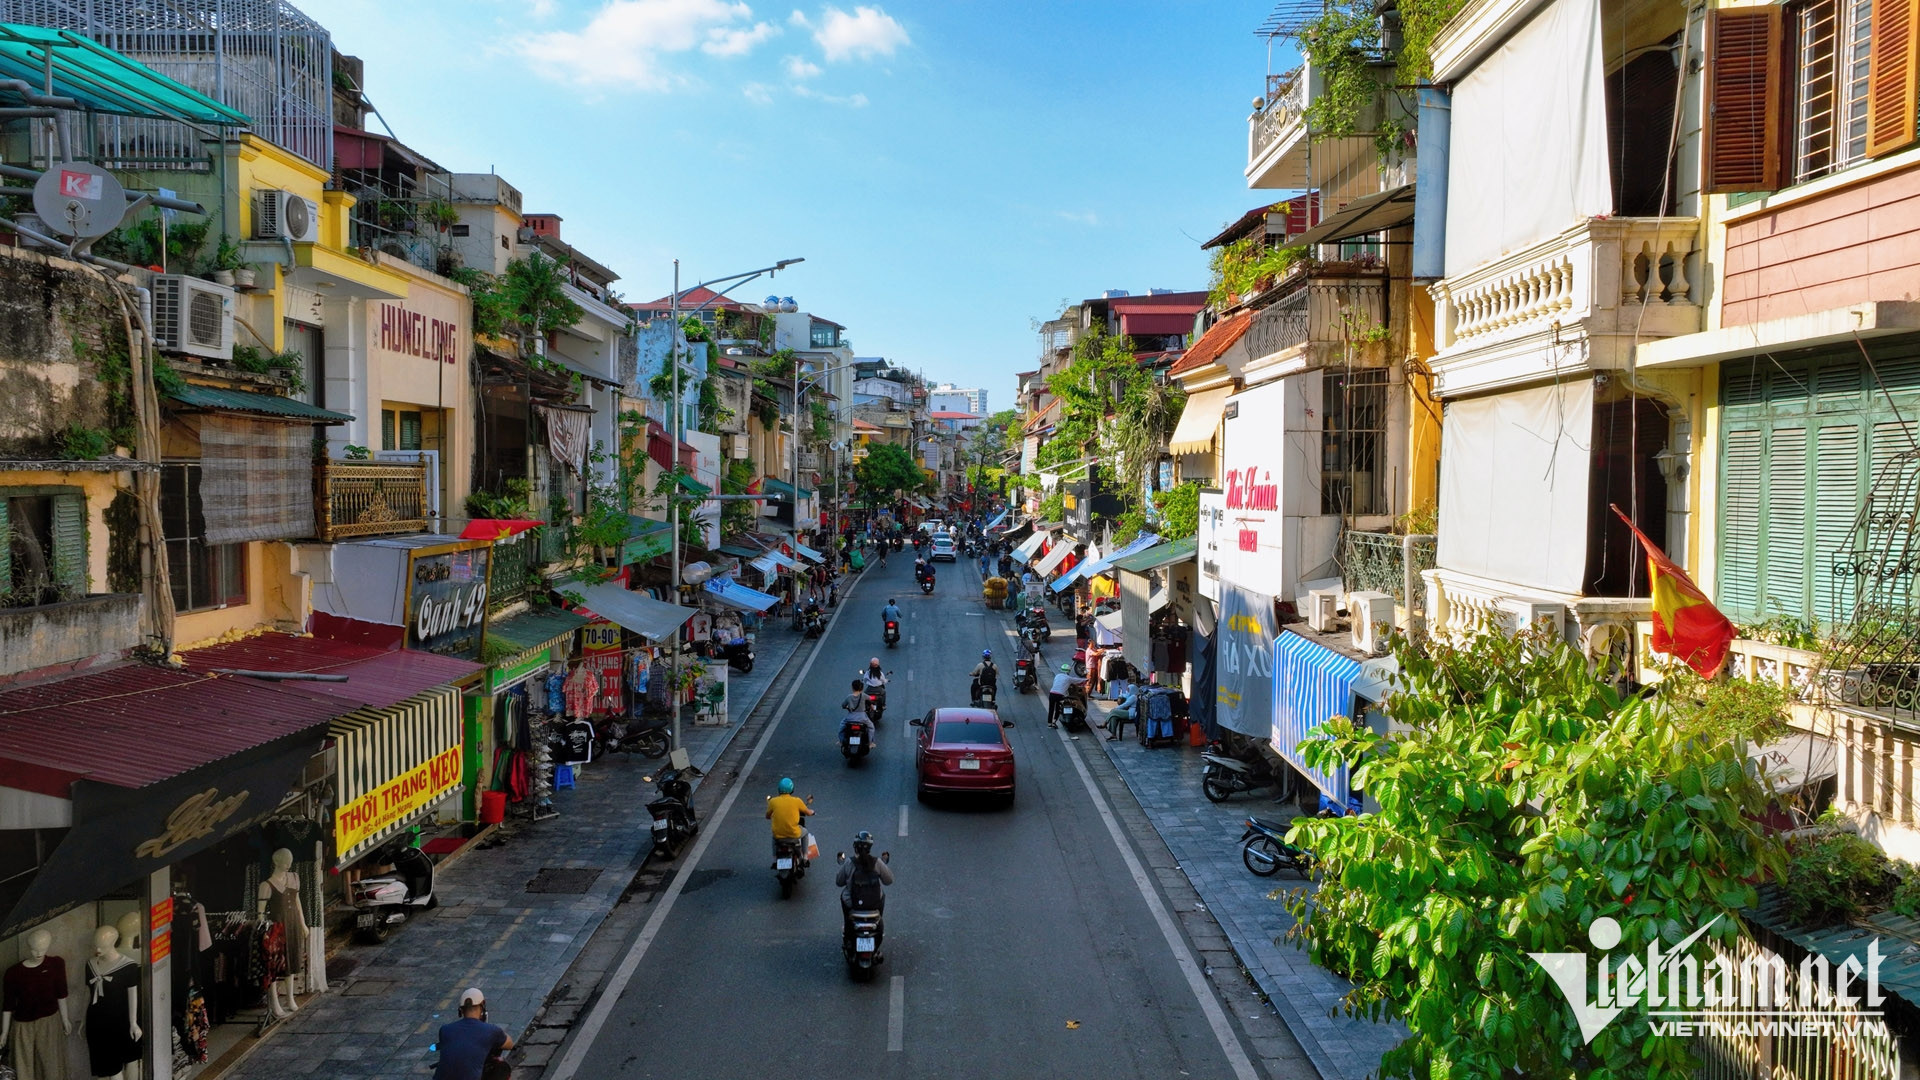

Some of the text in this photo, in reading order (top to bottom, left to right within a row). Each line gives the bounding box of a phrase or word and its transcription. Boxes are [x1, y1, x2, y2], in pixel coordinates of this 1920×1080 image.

[464, 583, 486, 629] 42
[1223, 633, 1240, 675] HÀ
[340, 747, 460, 836] THỜI TRANG MEO
